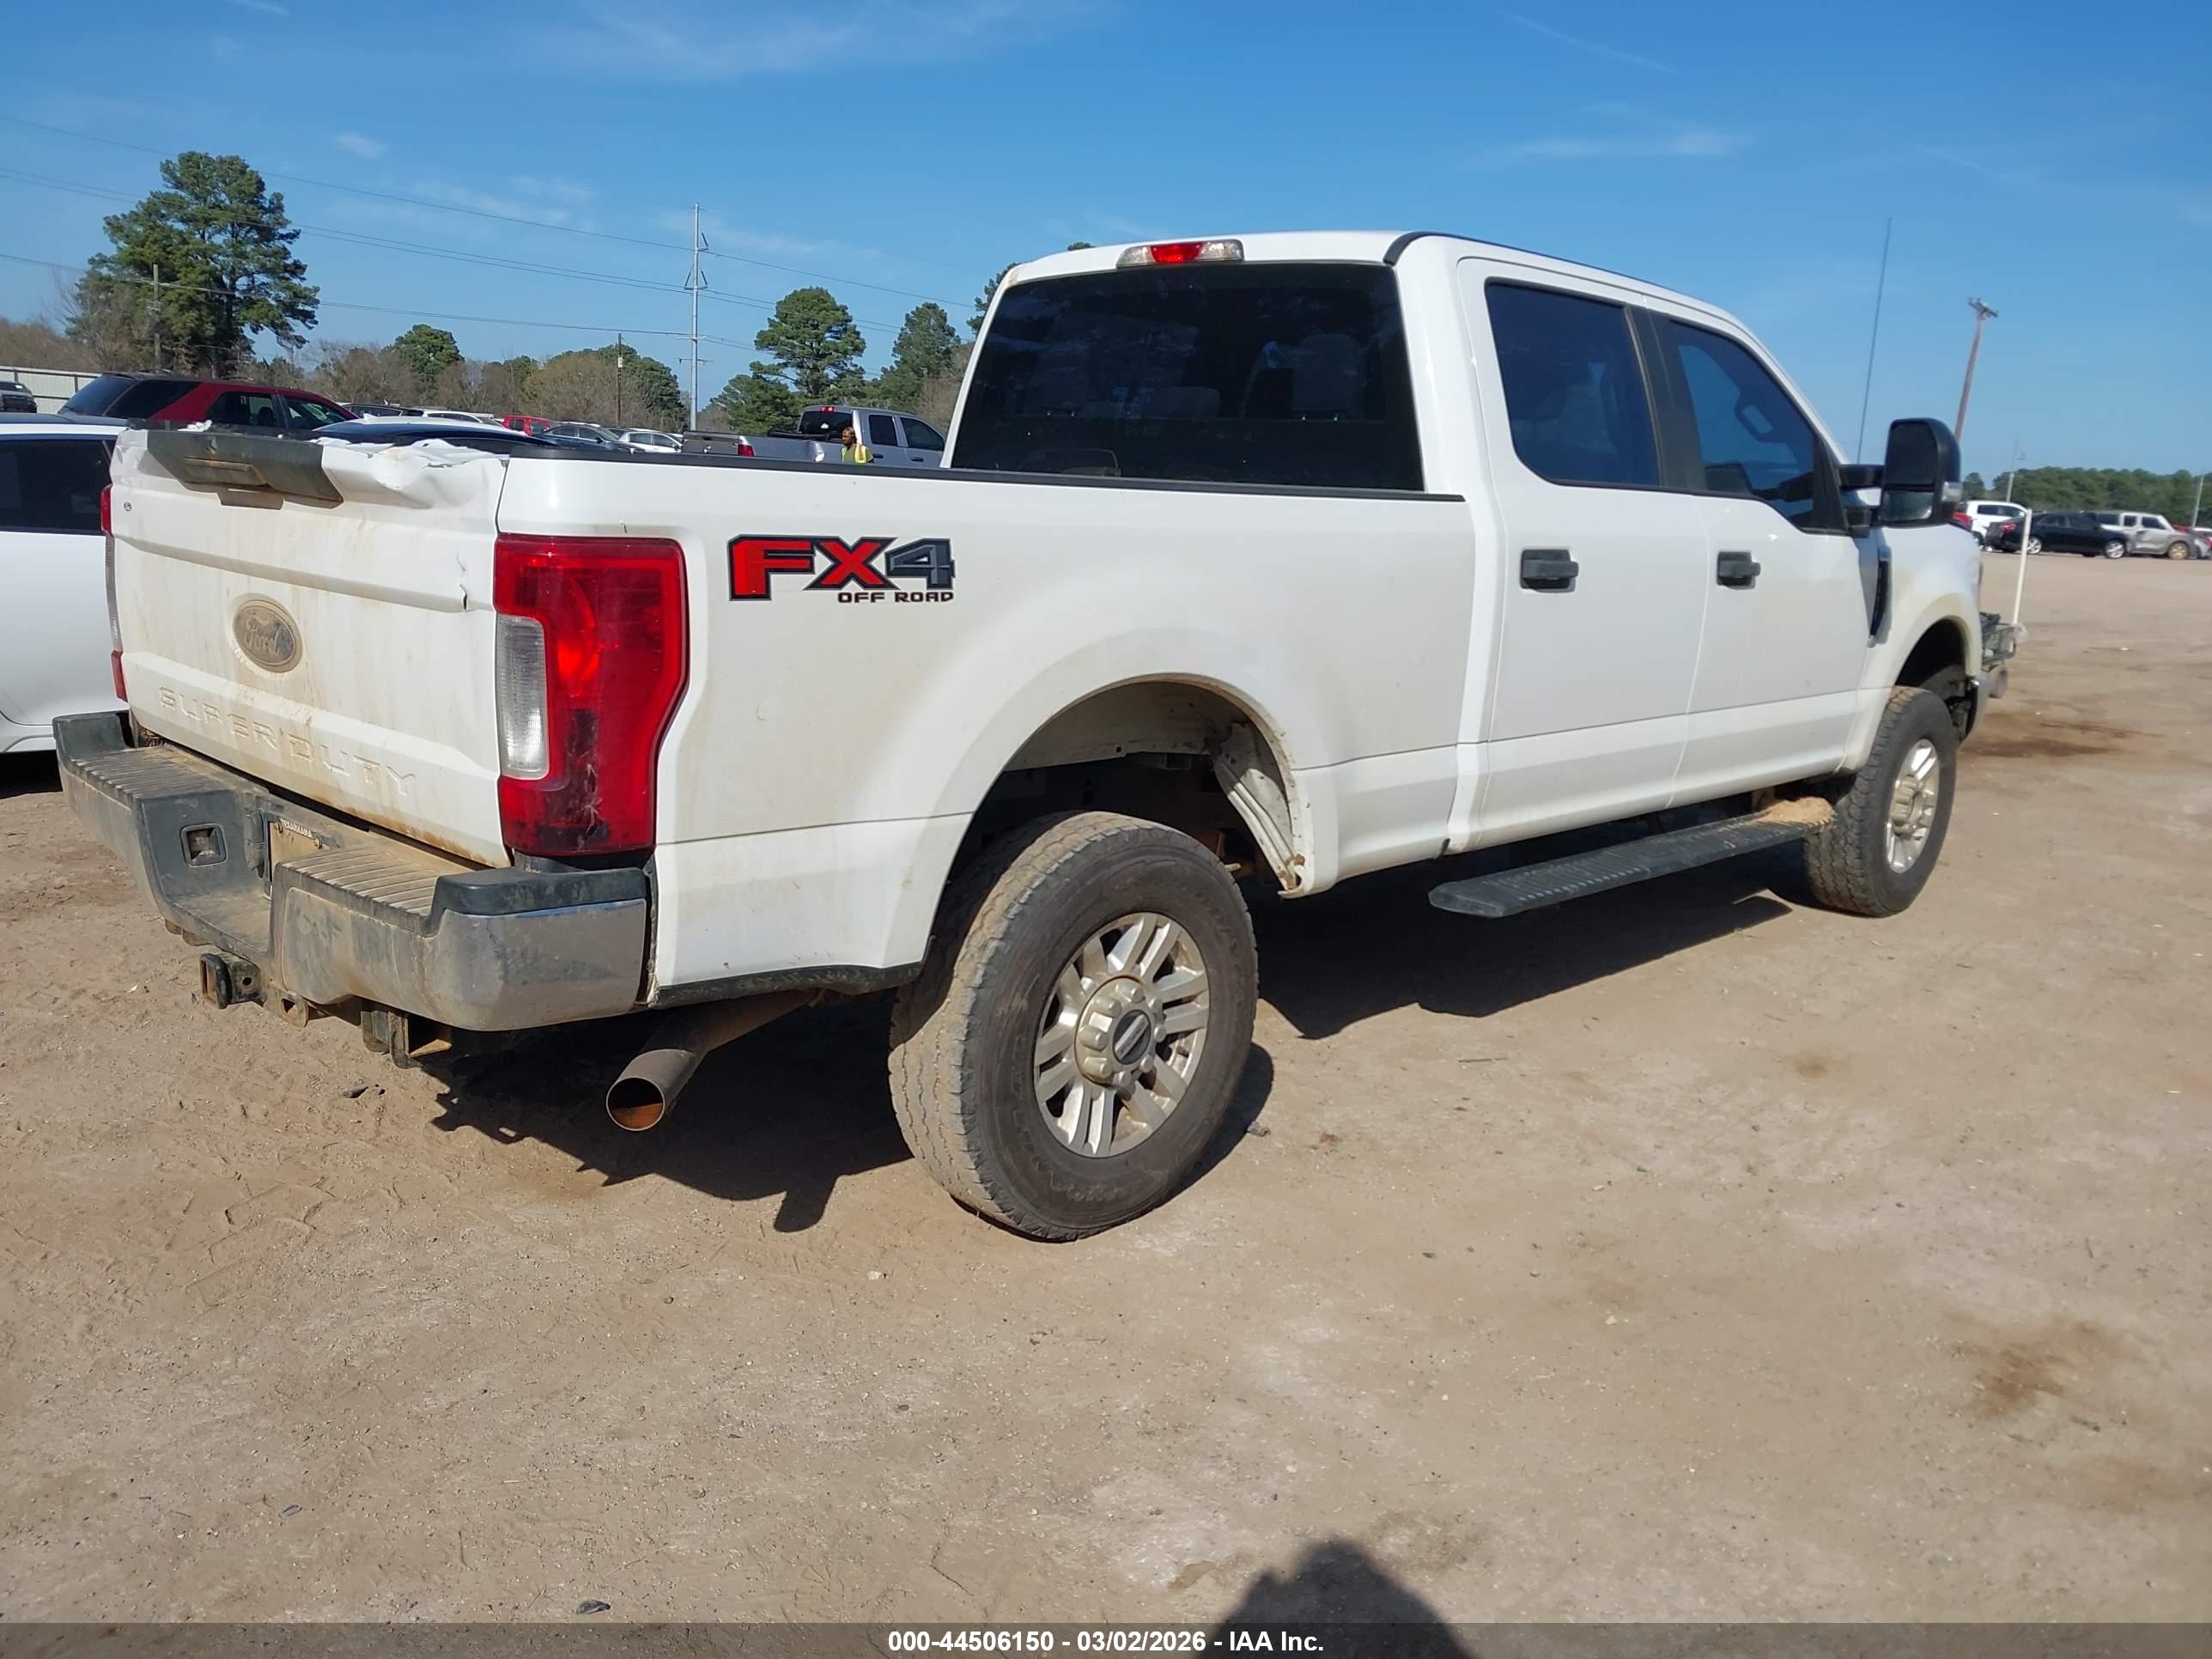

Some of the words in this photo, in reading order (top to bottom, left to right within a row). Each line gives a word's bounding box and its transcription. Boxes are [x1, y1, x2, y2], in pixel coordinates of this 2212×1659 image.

[726, 534, 955, 601] FX4
[837, 592, 885, 604] OFF
[895, 591, 954, 603] ROAD
[243, 613, 285, 657] Ford
[158, 686, 278, 750] SUPER
[288, 733, 416, 797] DUTY
